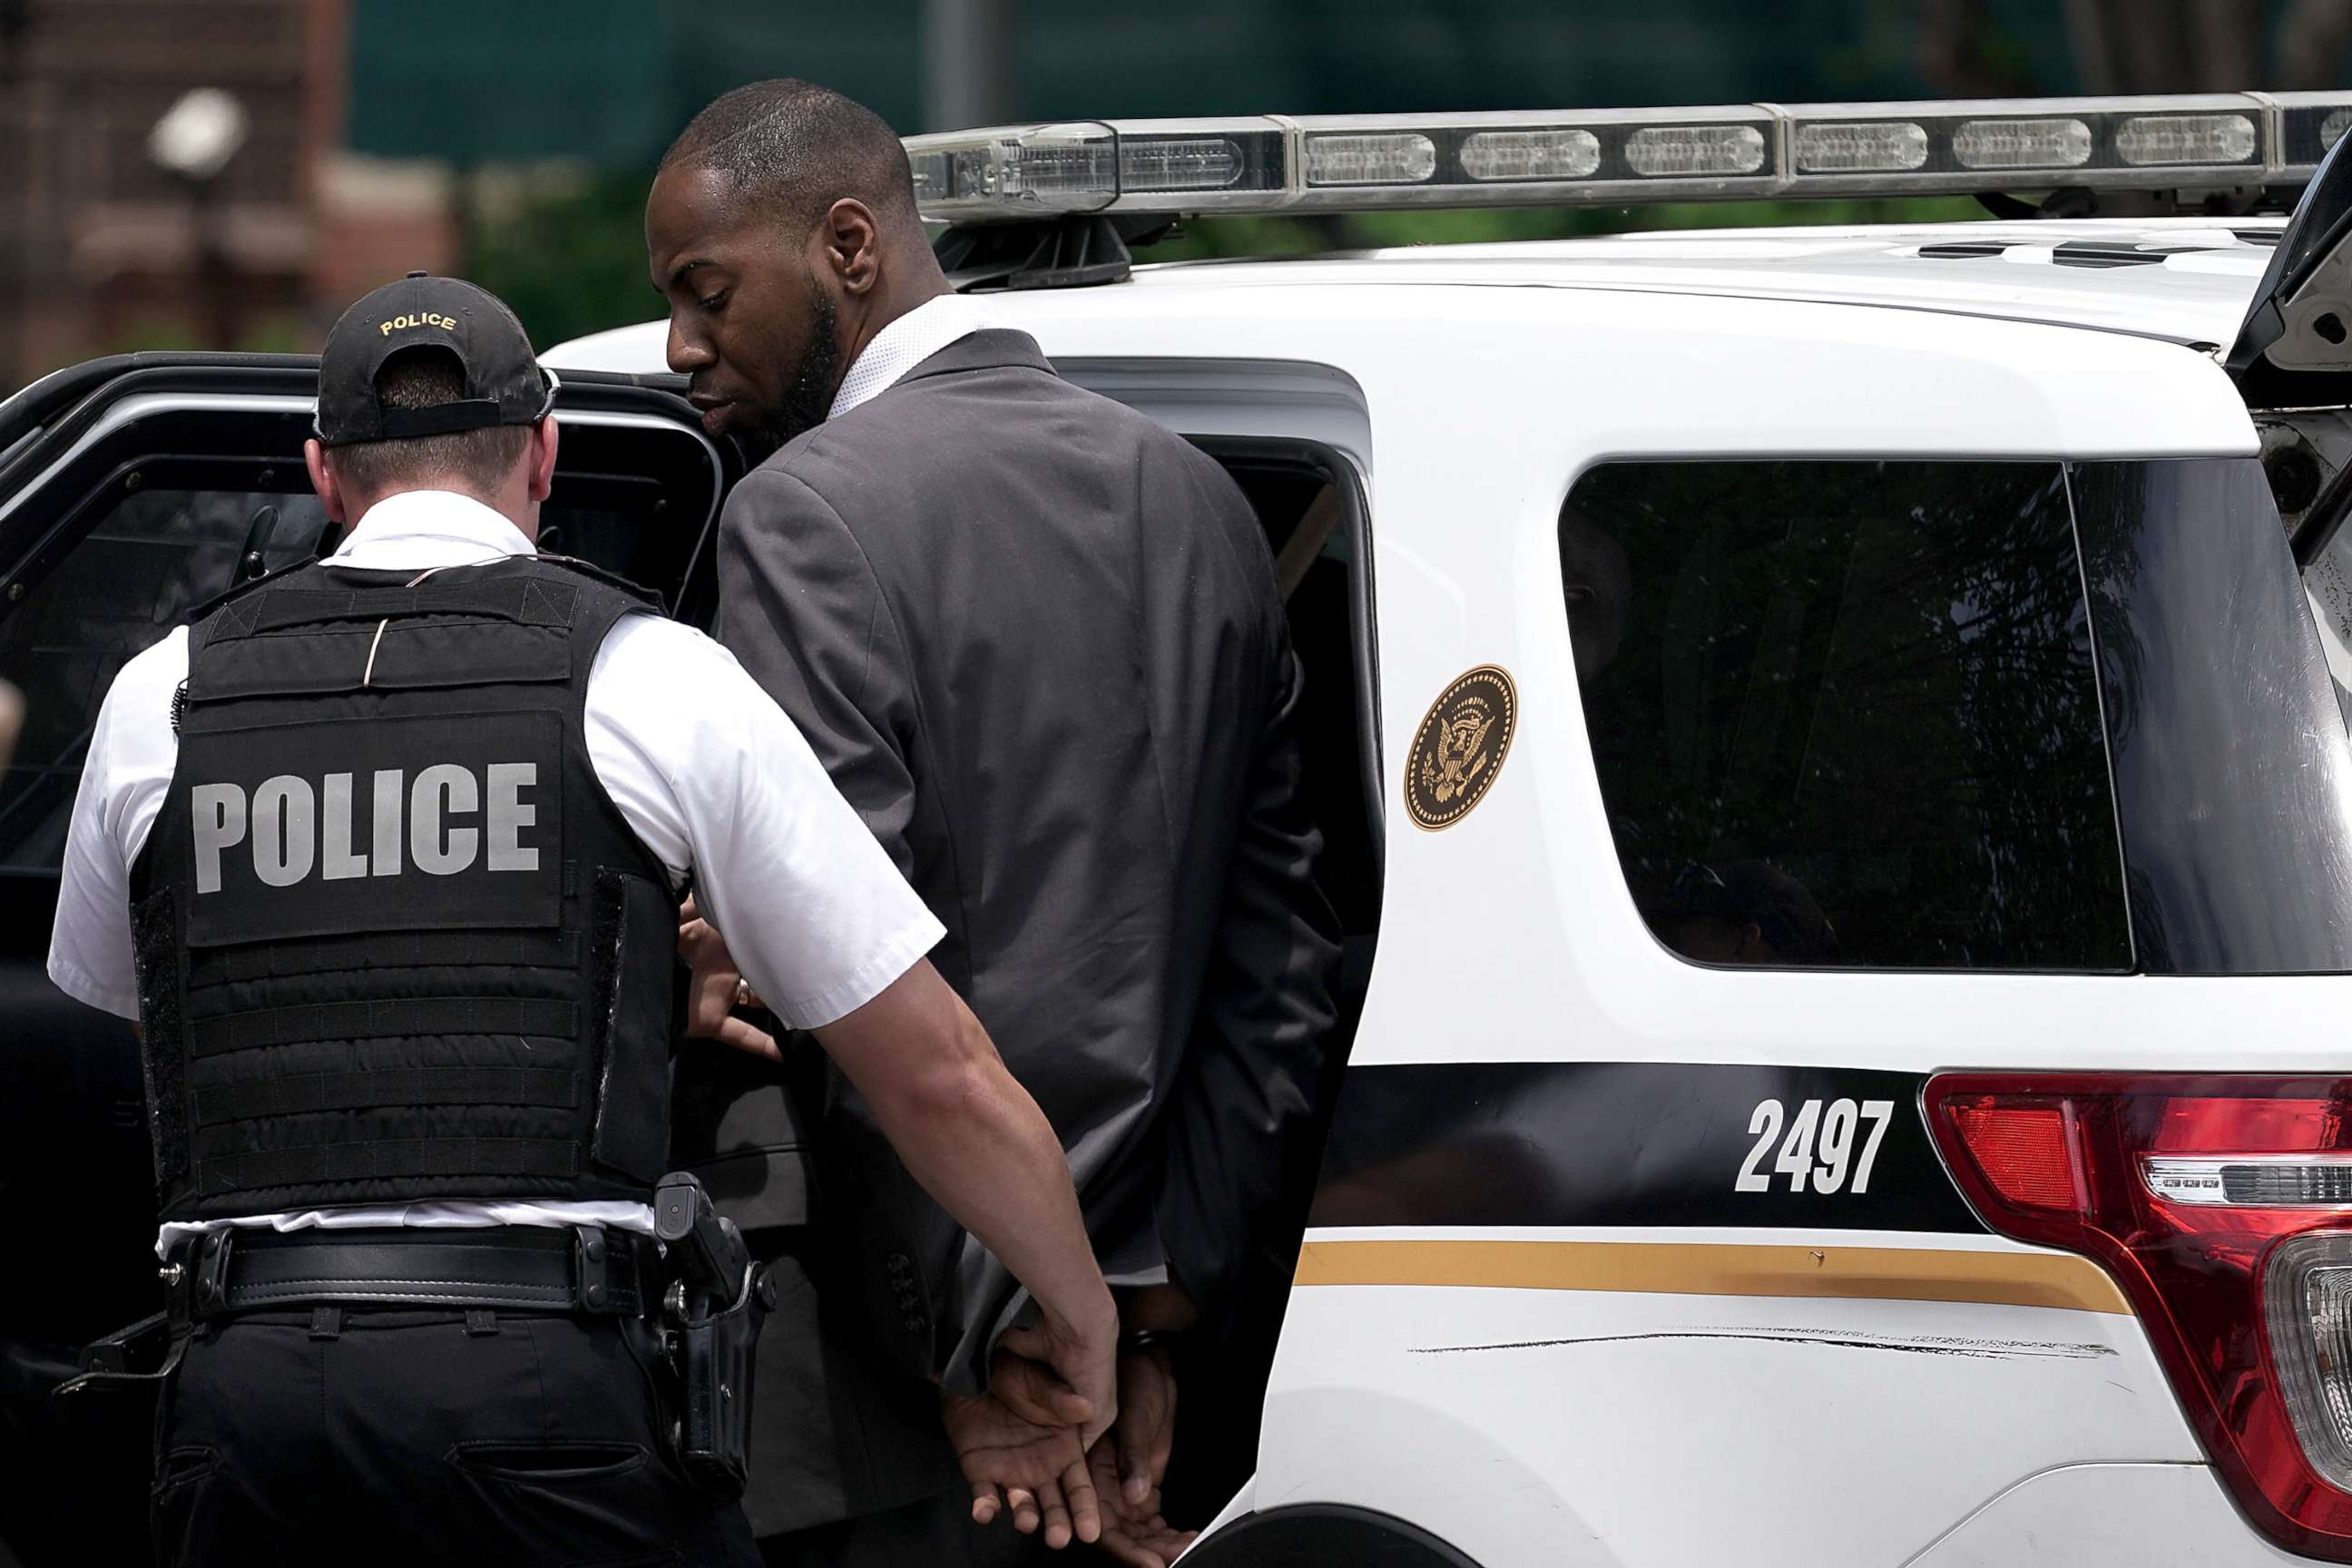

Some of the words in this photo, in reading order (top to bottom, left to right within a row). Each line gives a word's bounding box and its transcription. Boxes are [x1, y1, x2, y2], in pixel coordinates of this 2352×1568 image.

[380, 312, 457, 336] POLICE
[191, 762, 540, 895] POLICE
[1734, 1098, 1896, 1195] 2497
